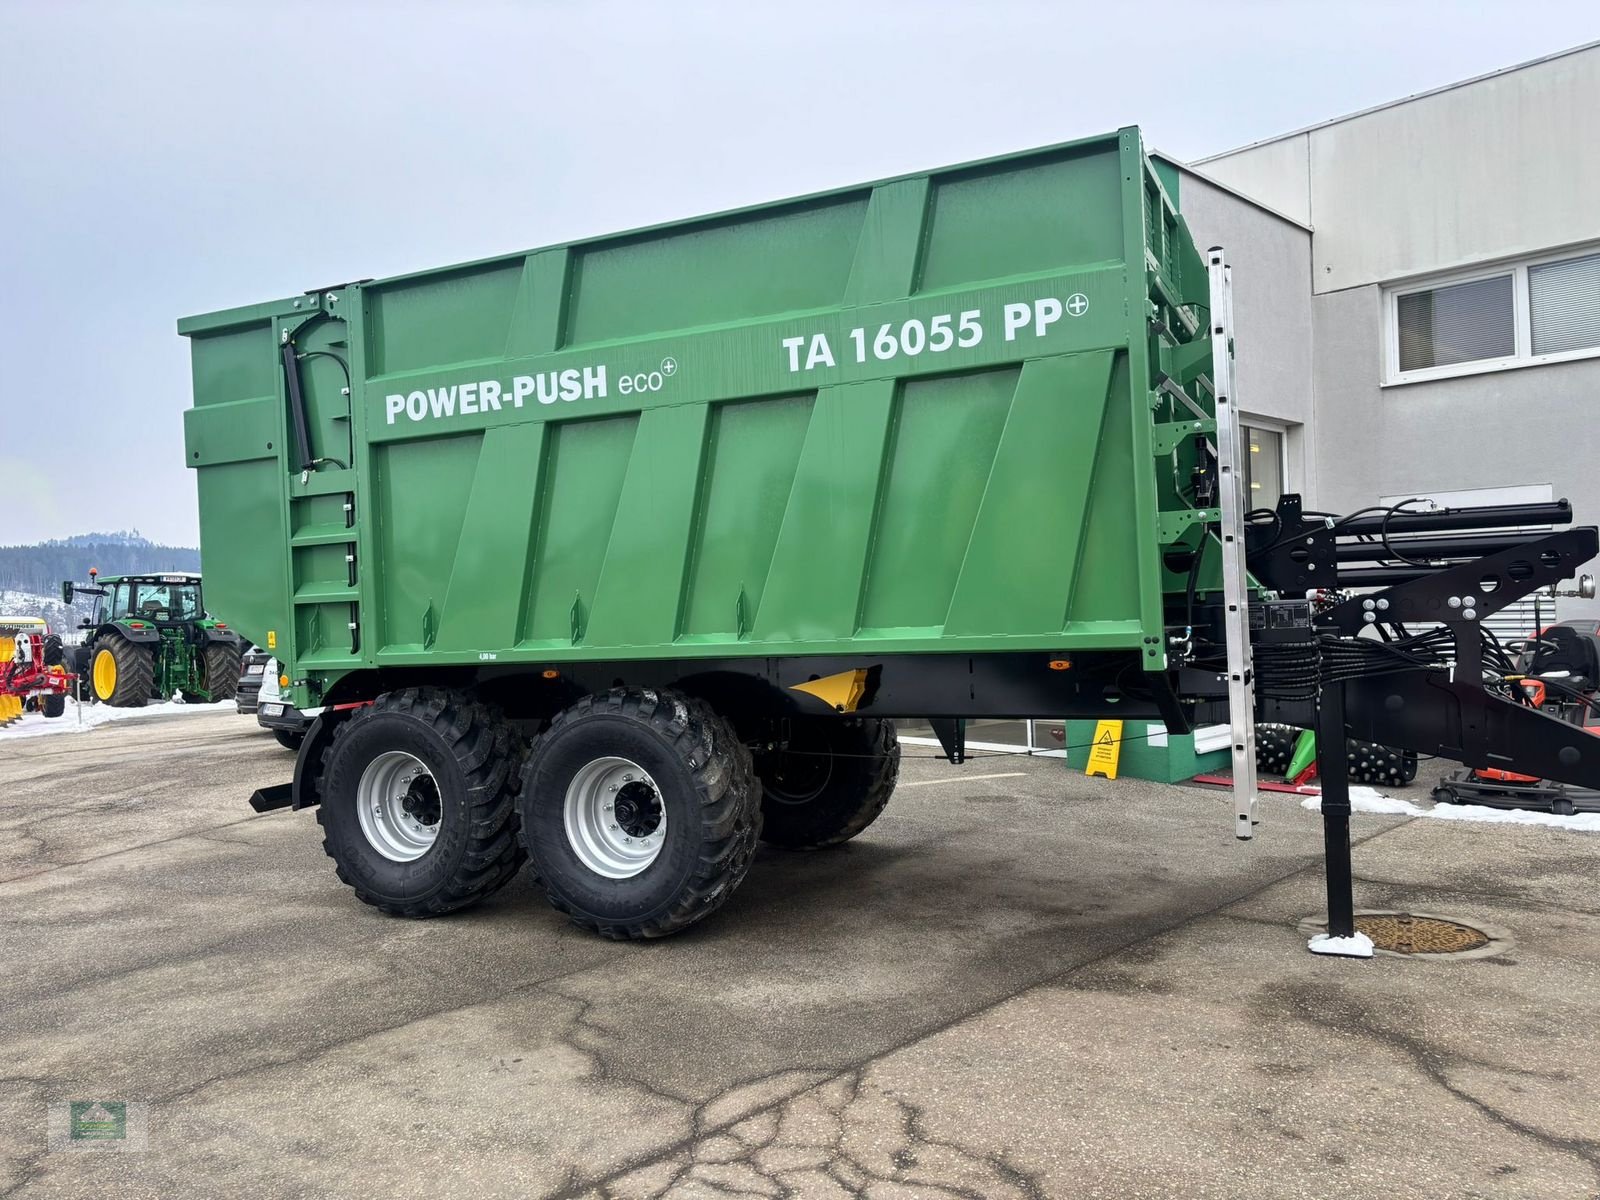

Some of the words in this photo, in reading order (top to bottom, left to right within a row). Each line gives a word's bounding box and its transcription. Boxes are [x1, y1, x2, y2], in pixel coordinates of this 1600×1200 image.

[783, 333, 836, 372] TA
[849, 309, 983, 363] 16055
[385, 365, 608, 425] POWER-PUSH
